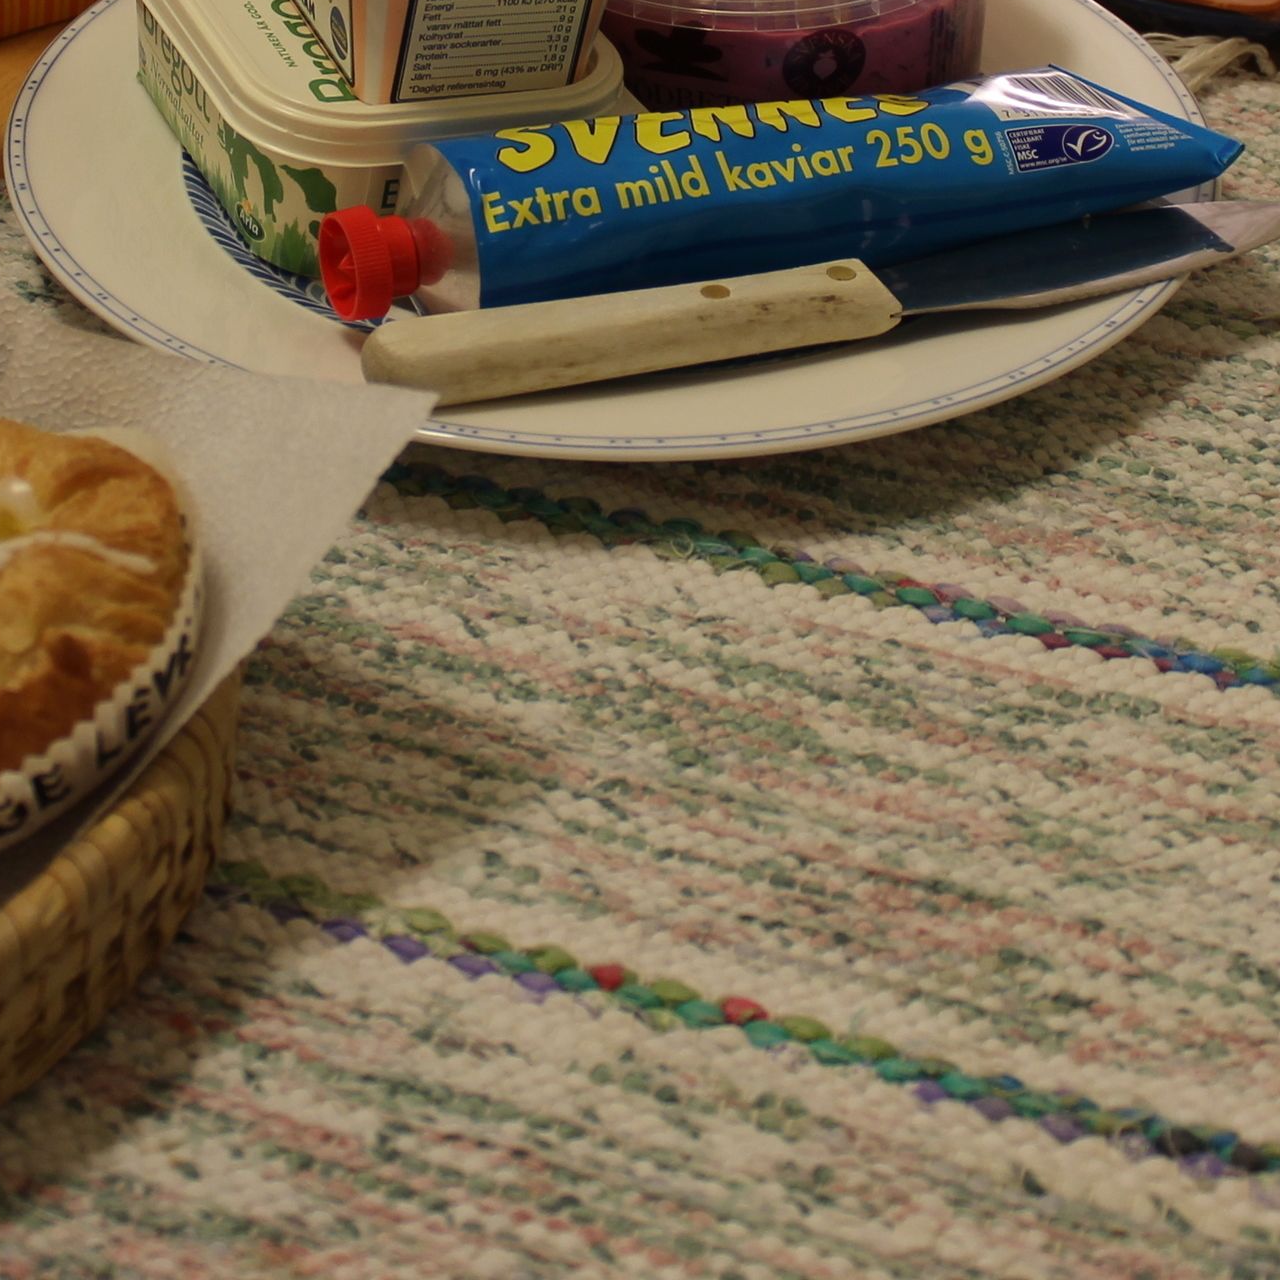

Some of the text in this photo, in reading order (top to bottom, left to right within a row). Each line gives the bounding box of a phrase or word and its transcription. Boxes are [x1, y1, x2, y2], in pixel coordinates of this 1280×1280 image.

[422, 13, 442, 22] Fett
[556, 5, 568, 14] 21
[424, 3, 455, 13] Energi
[426, 23, 452, 32] varav
[485, 19, 502, 28] fett
[418, 30, 464, 43] Kolhydrat
[552, 24, 565, 33] 10
[257, 19, 299, 69] NATUREN ÄR
[422, 41, 448, 51] varav
[449, 39, 502, 50] sockerarter
[414, 51, 449, 62] Protein
[412, 62, 432, 72] Salt
[483, 68, 498, 78] mg
[1008, 128, 1046, 139] CERTIFIERAT
[1011, 135, 1043, 146] HÅLLBART
[1017, 149, 1040, 161] MSC
[481, 121, 995, 234] Extra mild kaviar 250 g
[237, 207, 261, 237] Arla
